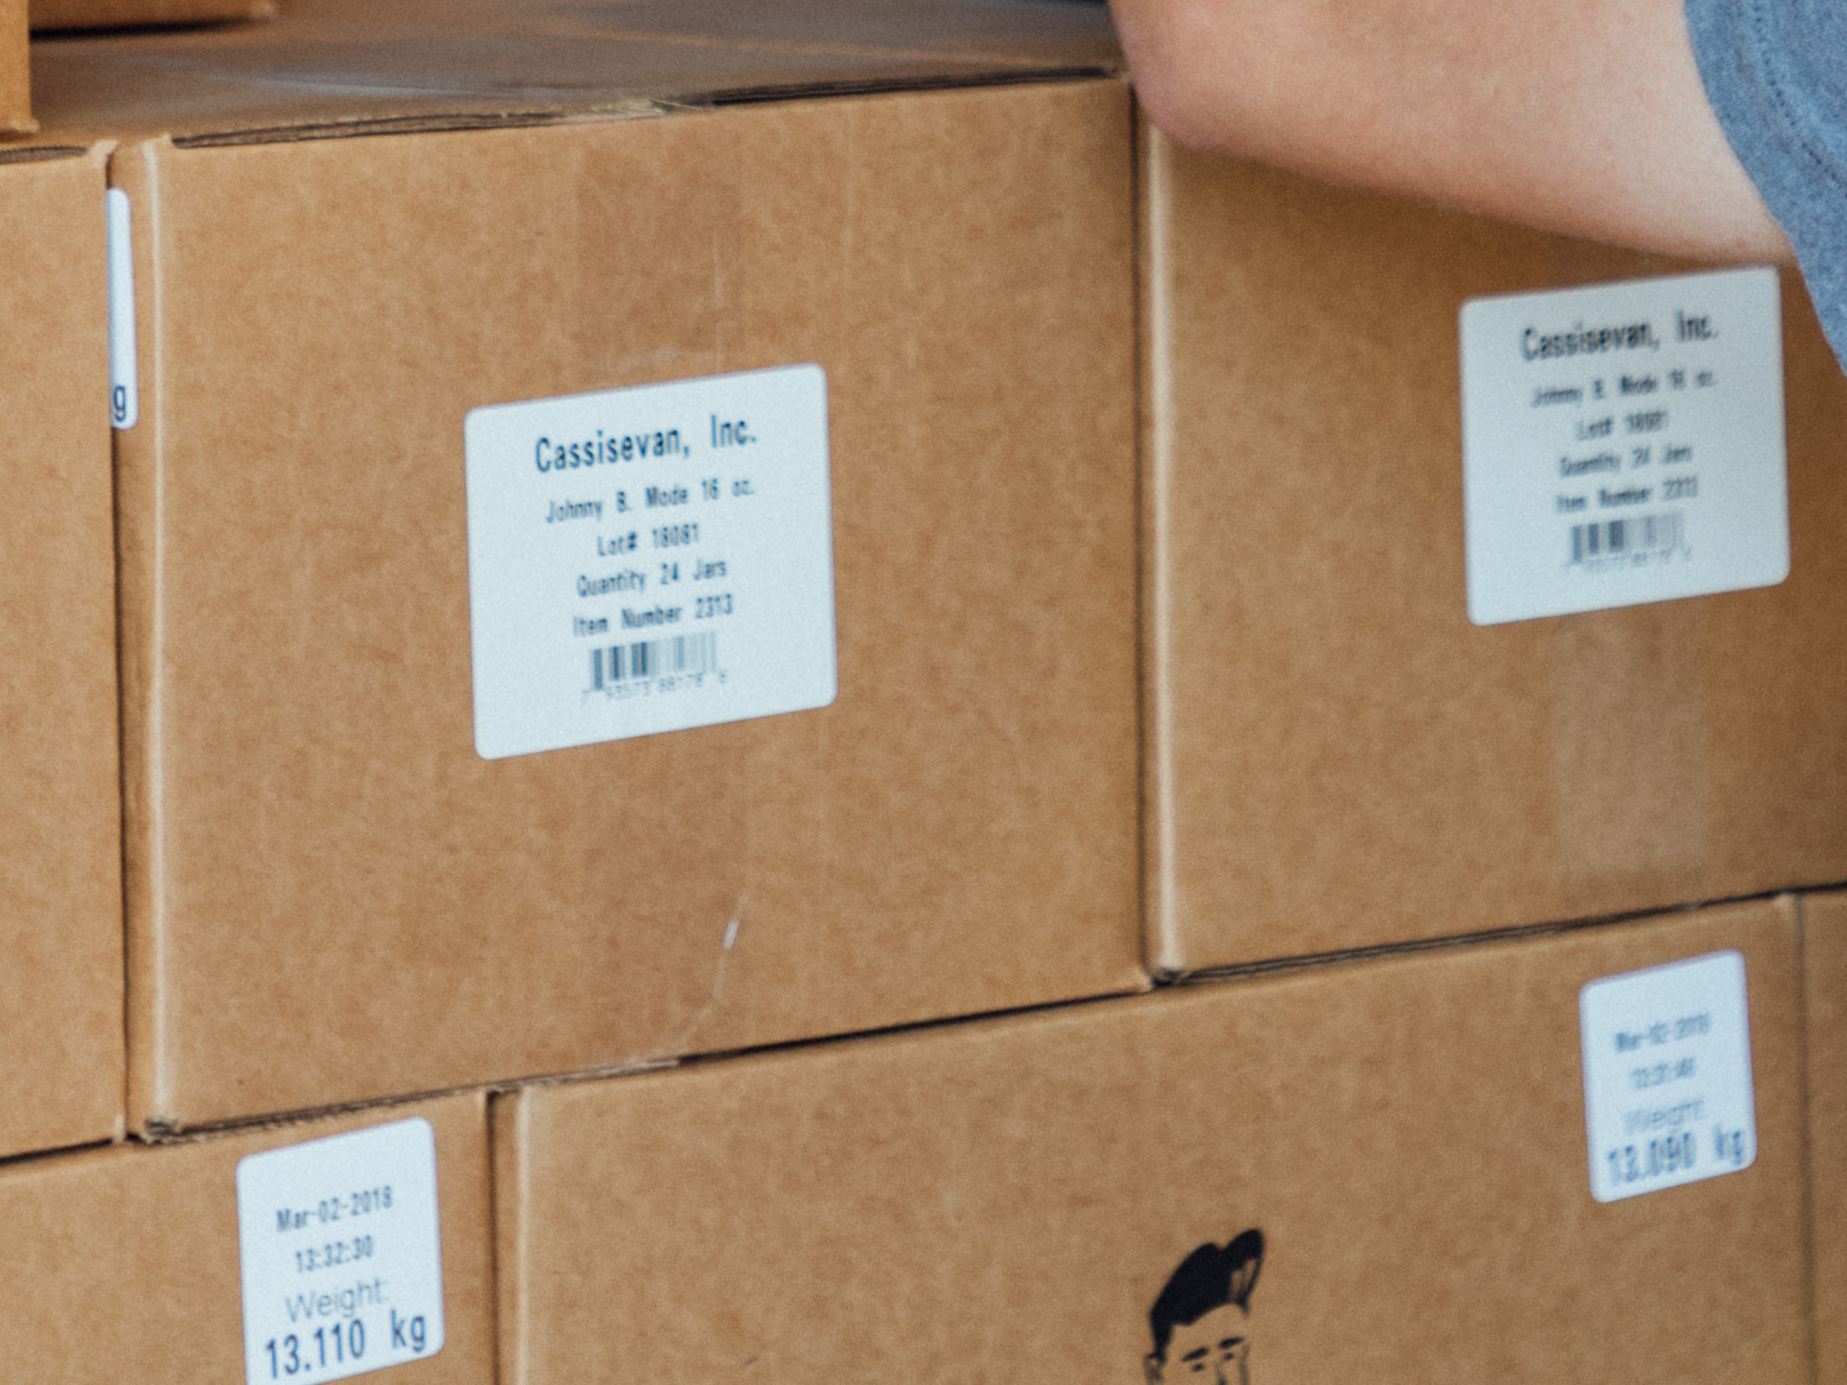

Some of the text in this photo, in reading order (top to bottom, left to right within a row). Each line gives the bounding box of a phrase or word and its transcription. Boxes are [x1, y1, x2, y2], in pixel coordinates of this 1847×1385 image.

[534, 413, 758, 474] Cassisevan, Inc.
[545, 499, 604, 525] Johnny
[645, 485, 689, 509] Mode
[701, 477, 720, 501] 16
[596, 530, 638, 558] Lot#
[576, 558, 727, 599] Quantity 24 Jars
[573, 592, 734, 638] Item Number 2313
[275, 1184, 393, 1233] Mar-02-2018
[293, 1234, 375, 1273] 13:32:30
[283, 1276, 392, 1324] Weight:
[264, 1307, 428, 1381] 13.110 kg
